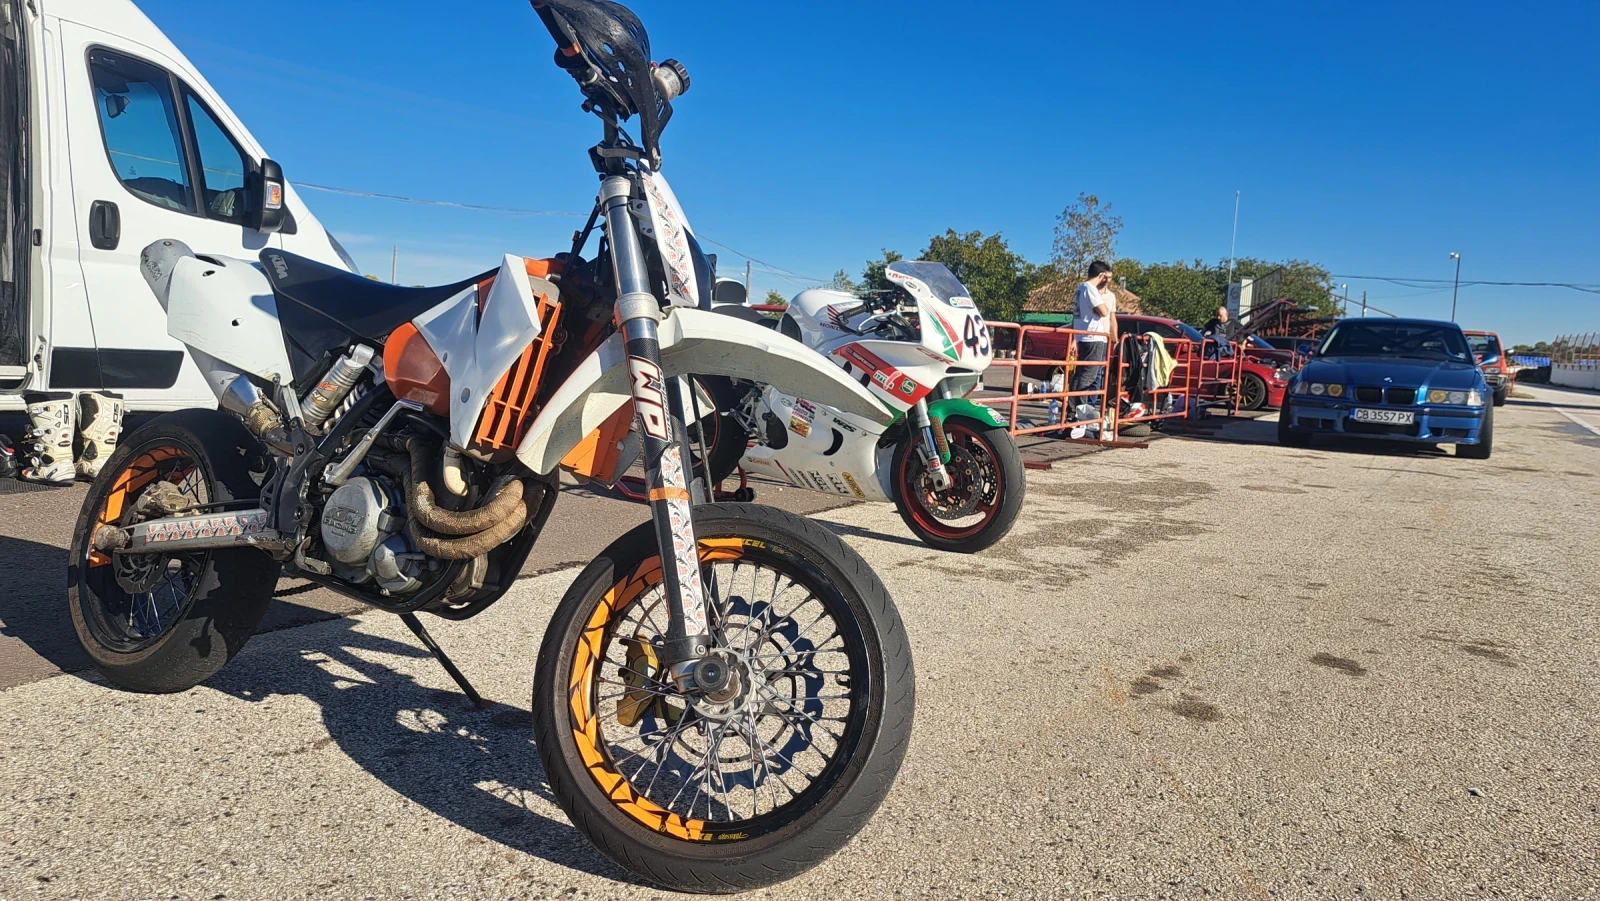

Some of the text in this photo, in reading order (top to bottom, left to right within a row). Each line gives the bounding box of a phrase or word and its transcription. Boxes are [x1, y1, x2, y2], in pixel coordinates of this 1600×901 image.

[268, 254, 288, 279] KTM
[820, 322, 845, 333] HOND
[963, 313, 989, 358] 43
[874, 373, 894, 389] ITALA
[629, 356, 669, 441] WP
[1356, 409, 1412, 423] CB 3557 PX
